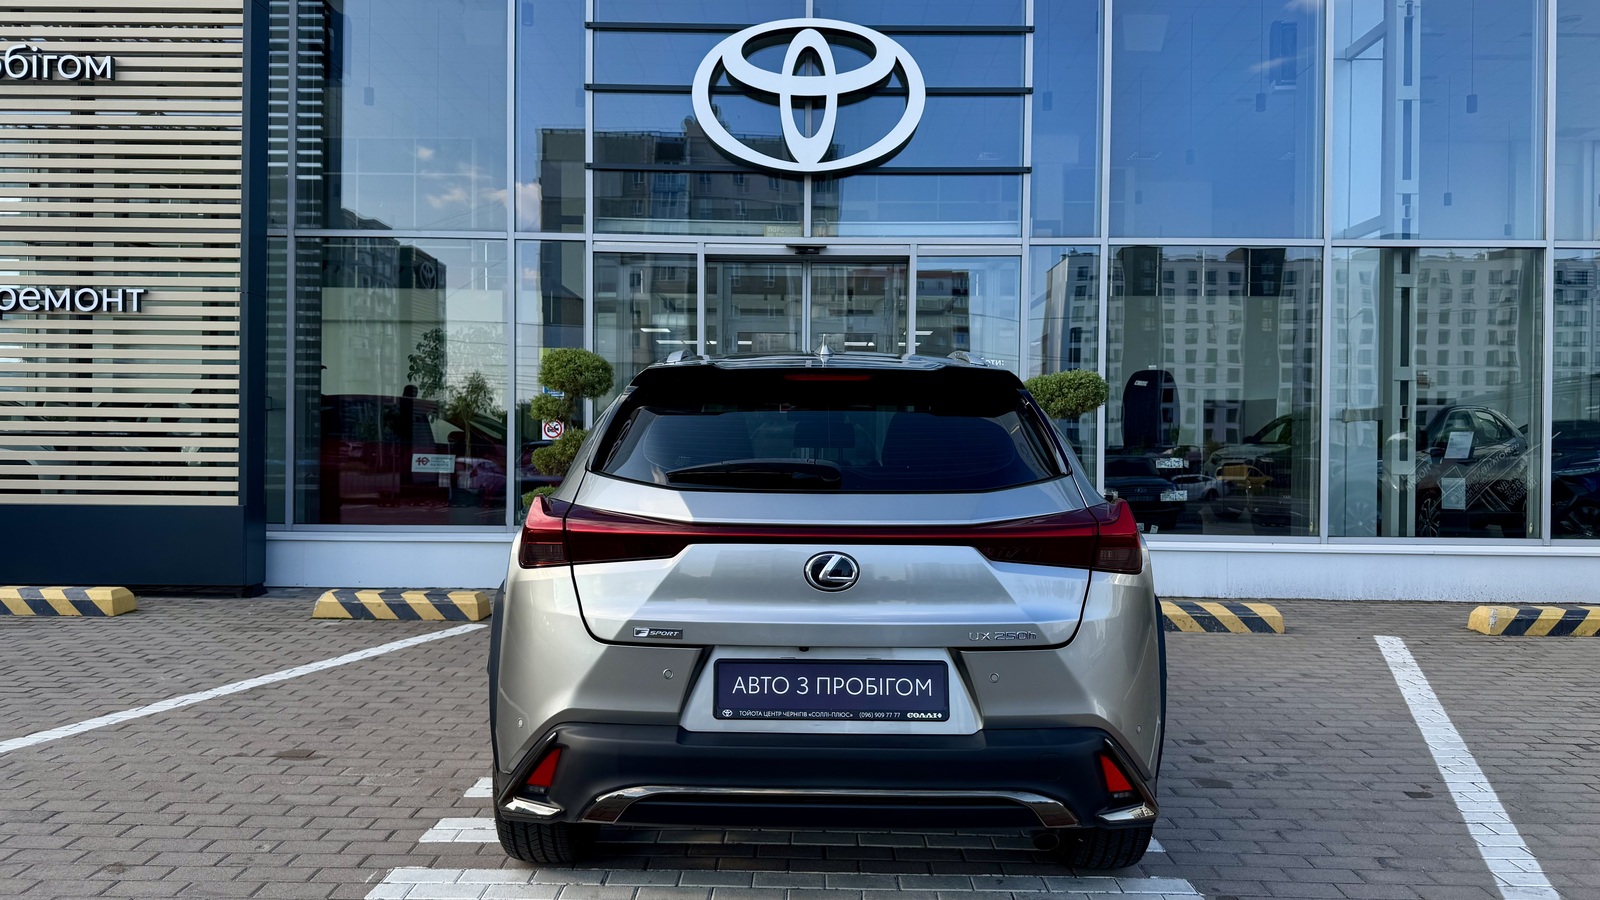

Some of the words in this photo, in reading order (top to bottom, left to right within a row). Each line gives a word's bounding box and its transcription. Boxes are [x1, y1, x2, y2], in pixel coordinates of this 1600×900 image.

[0, 44, 112, 79] бігом
[969, 631, 991, 641] UX
[994, 630, 1037, 641] 250h
[732, 676, 790, 695] АВТО
[816, 676, 932, 697] ПРОБІГОМ
[859, 711, 874, 719] (096)
